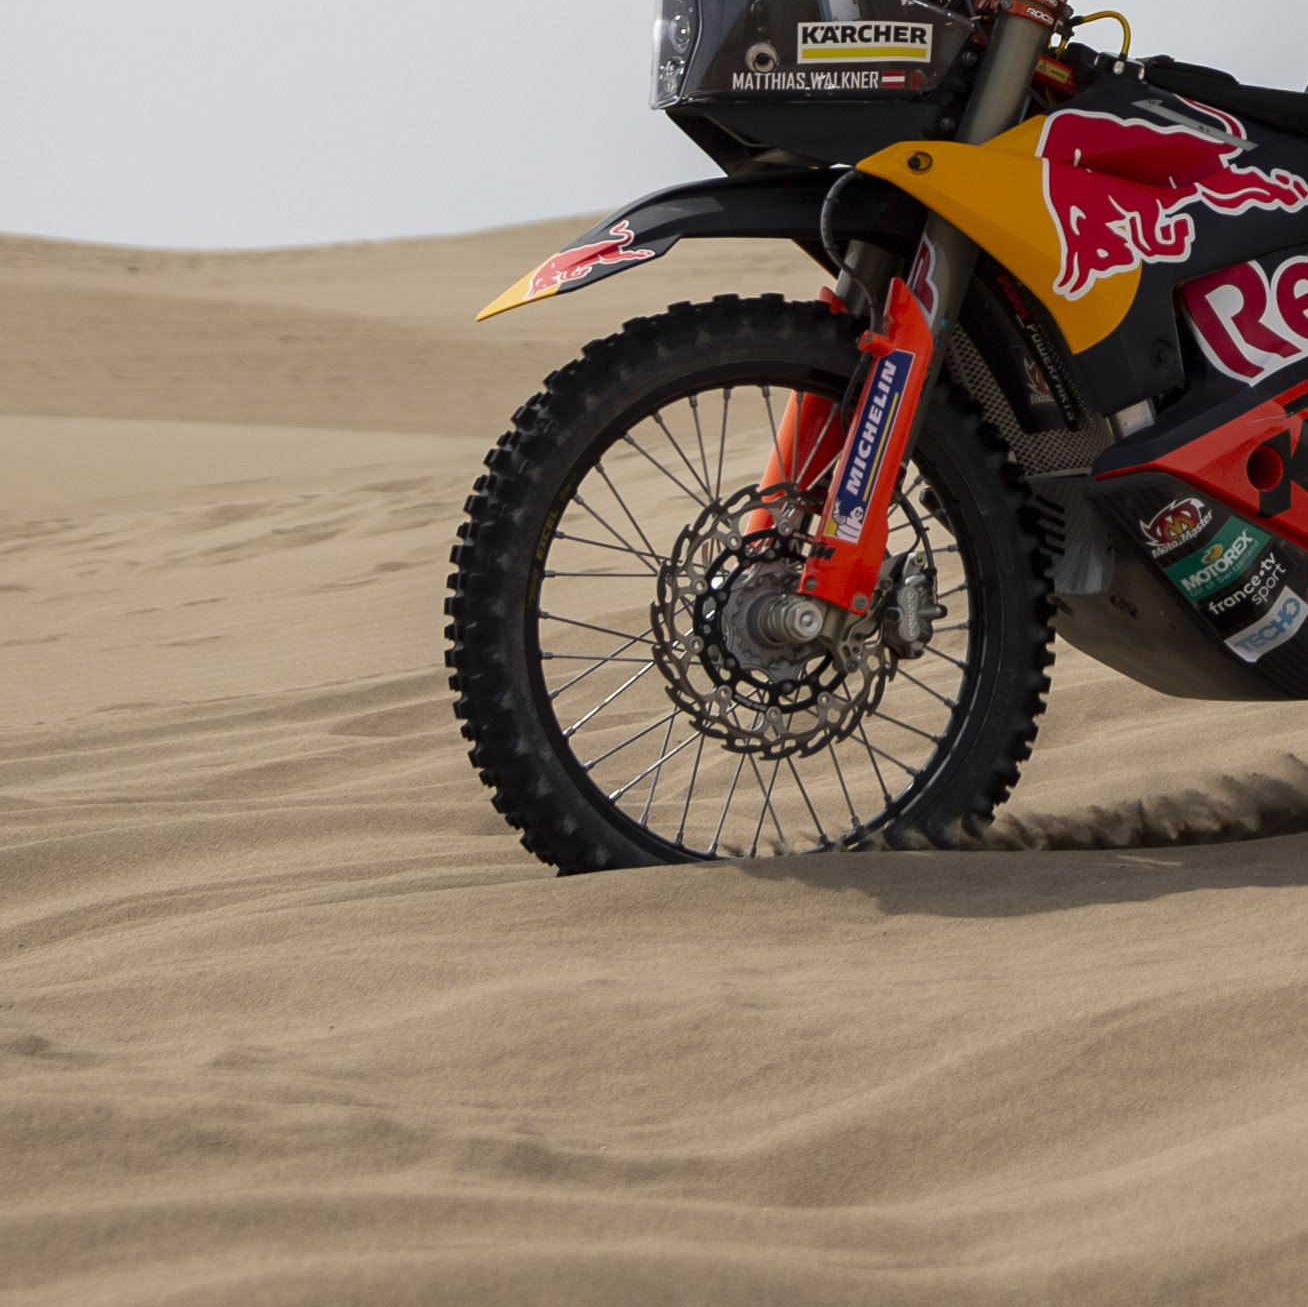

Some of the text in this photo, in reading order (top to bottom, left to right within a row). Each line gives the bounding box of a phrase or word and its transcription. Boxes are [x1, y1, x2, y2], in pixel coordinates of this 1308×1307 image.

[802, 25, 928, 45] KÄRCHER
[732, 72, 805, 90] MATTHIAS
[810, 71, 879, 90] WALKNER
[846, 360, 897, 496] MICHELIN
[1180, 529, 1254, 591] MOTOREX
[1252, 562, 1287, 605] sport
